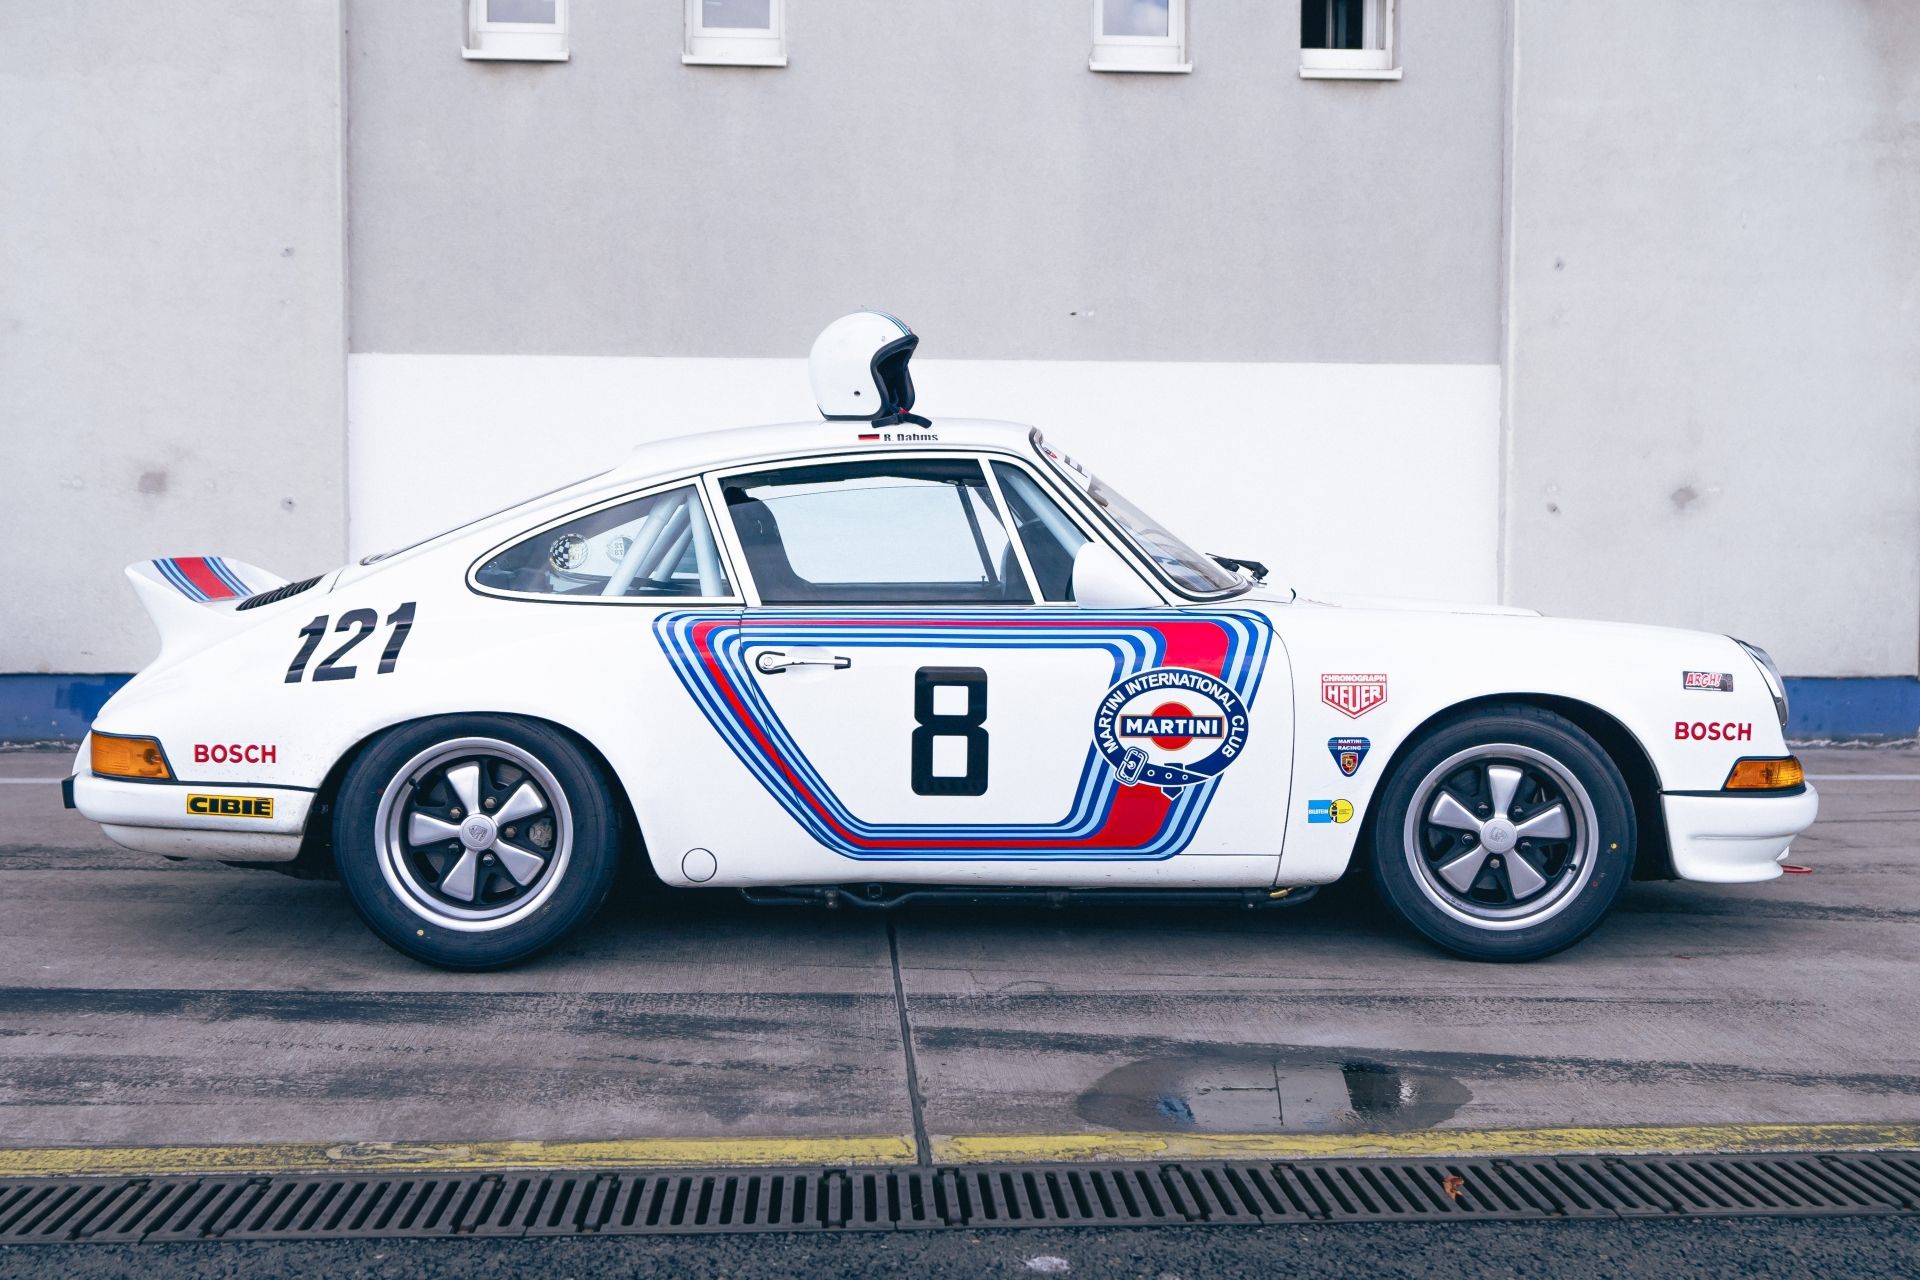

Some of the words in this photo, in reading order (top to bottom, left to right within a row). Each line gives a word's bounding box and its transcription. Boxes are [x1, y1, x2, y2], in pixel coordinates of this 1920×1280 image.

[897, 433, 939, 442] Dahms
[284, 602, 416, 684] 121
[1322, 674, 1386, 682] CHRONOGRAPH
[1326, 685, 1382, 712] HEUER
[1098, 690, 1127, 754] MARTINI
[1124, 672, 1235, 713] INTERNATIONAL
[1221, 715, 1245, 759] CLUB
[911, 665, 989, 796] 8
[1126, 718, 1218, 735] MARTINI
[1674, 721, 1752, 741] BOSCH
[194, 744, 276, 764] BOSCH
